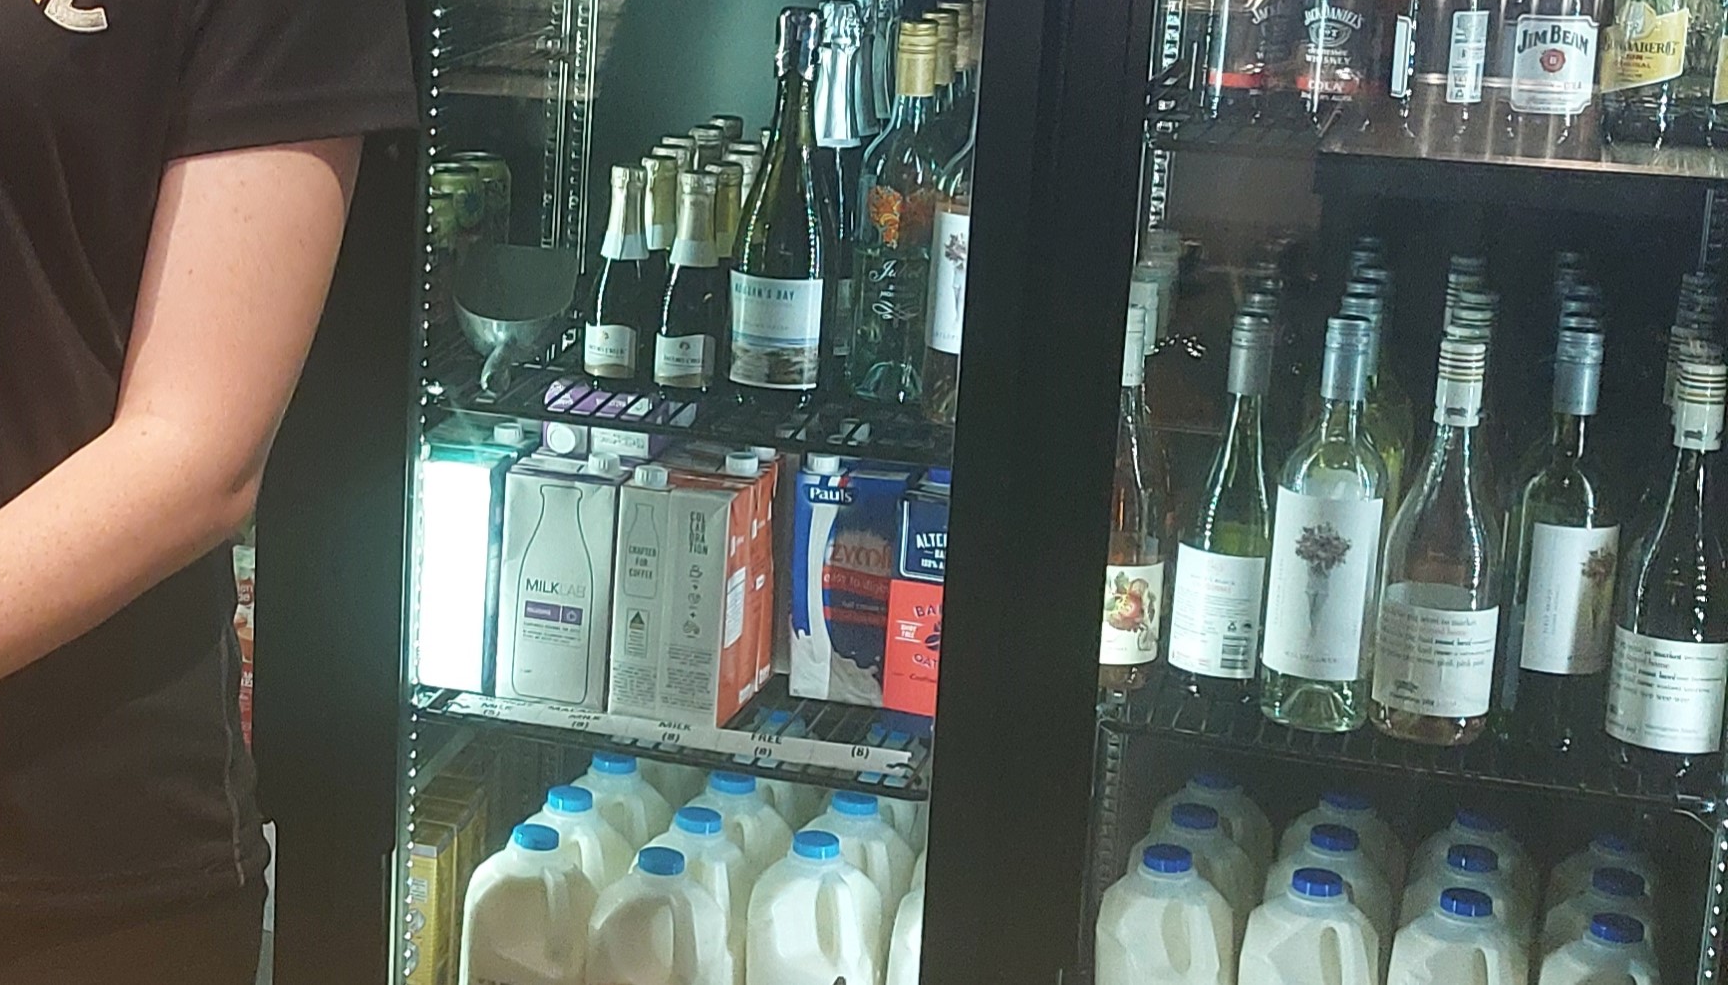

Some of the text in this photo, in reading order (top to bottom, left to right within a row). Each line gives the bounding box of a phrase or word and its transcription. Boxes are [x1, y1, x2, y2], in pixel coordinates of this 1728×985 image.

[1517, 24, 1590, 57] JIM BEAM
[1308, 79, 1343, 93] COLA
[809, 487, 853, 504] Pauls
[525, 577, 587, 599] MILKLAB
[658, 721, 692, 732] MILK
[750, 734, 783, 746] FREE
[851, 745, 871, 760] (8)
